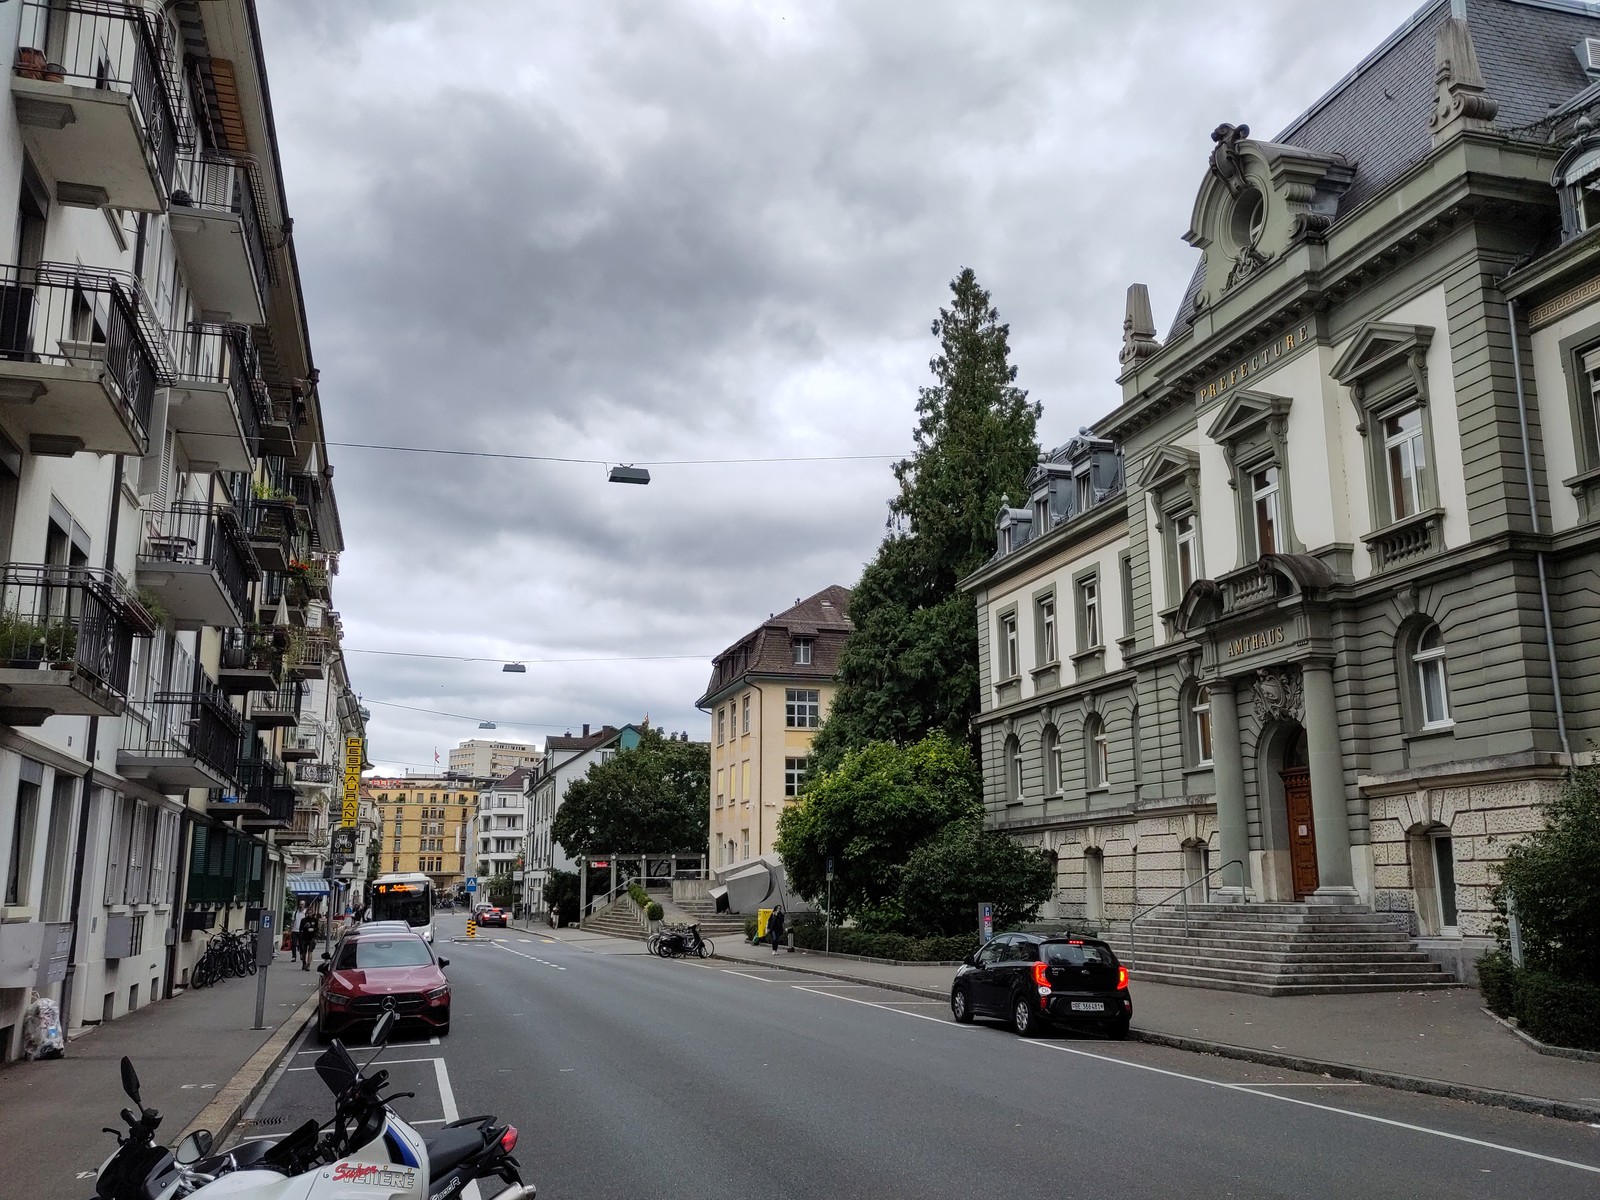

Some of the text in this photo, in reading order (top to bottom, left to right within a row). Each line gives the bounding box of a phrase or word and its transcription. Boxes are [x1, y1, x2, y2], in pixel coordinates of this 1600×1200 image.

[1200, 325, 1308, 403] PREFECTURE
[1228, 626, 1284, 657] AMTHAUS
[344, 738, 360, 826] RESTAURANT
[379, 885, 386, 893] 11
